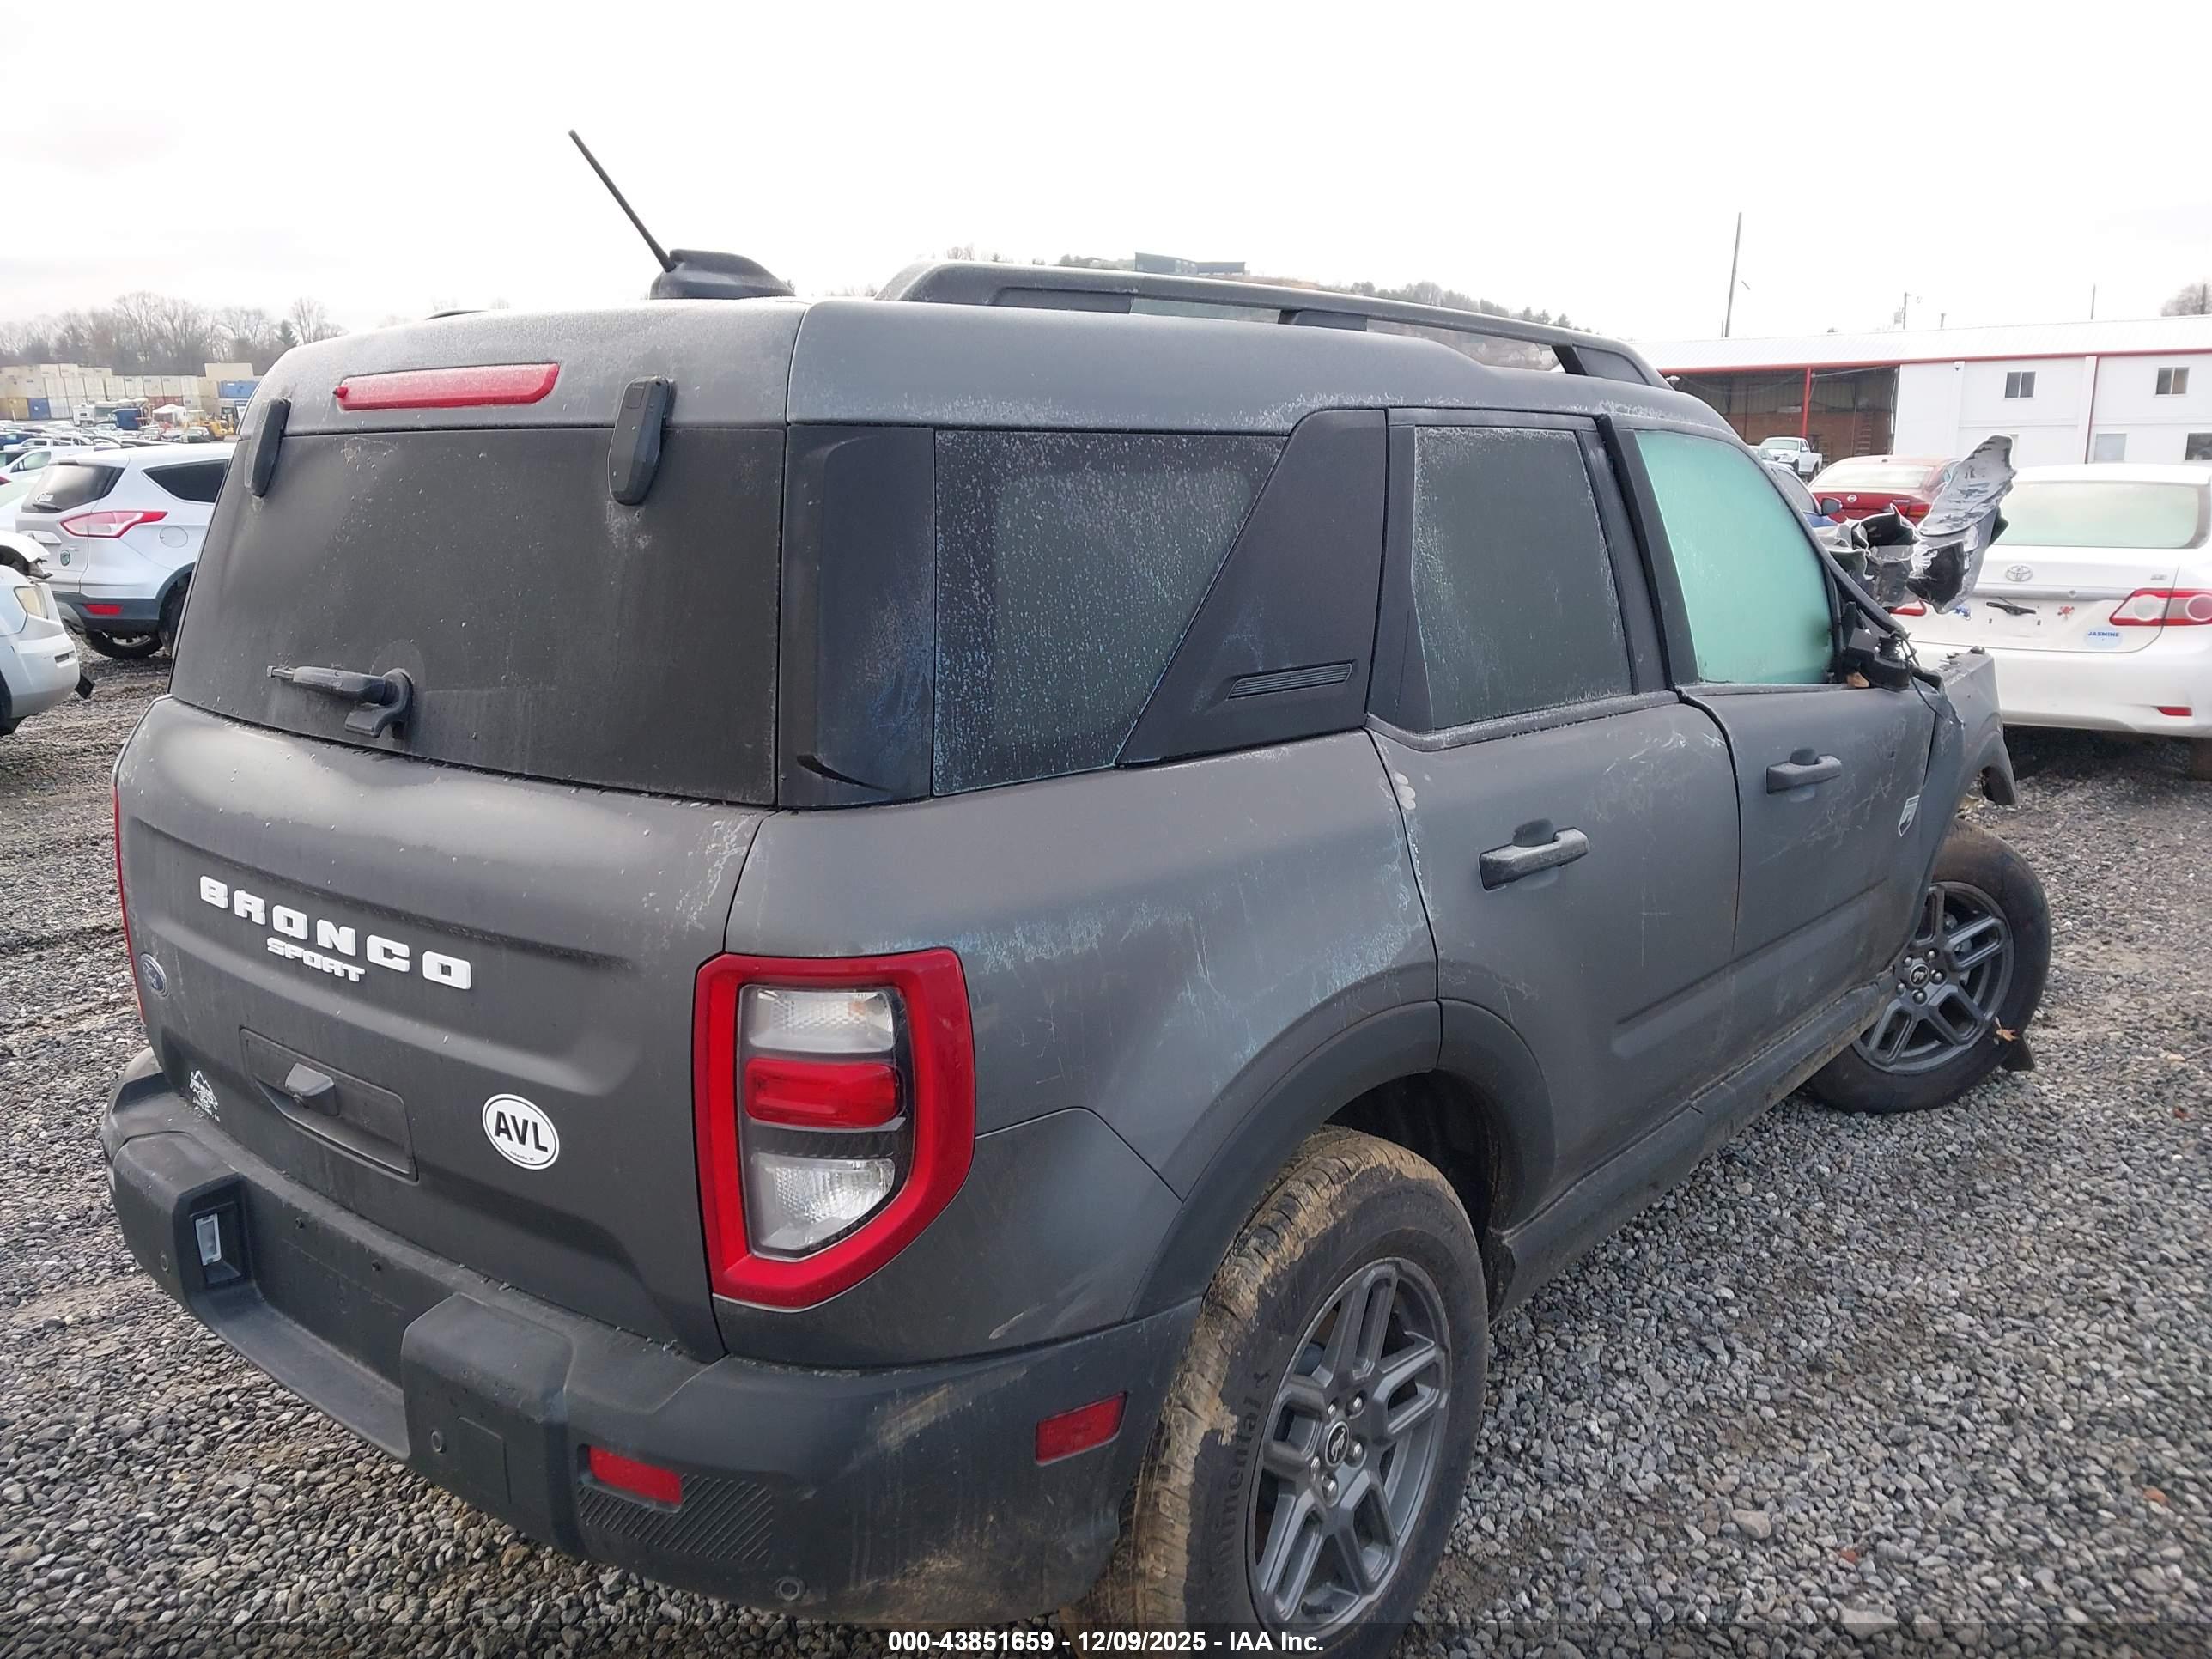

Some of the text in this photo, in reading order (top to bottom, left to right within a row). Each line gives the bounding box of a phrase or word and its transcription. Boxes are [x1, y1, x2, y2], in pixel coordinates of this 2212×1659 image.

[199, 875, 471, 989] BRONCO
[266, 937, 366, 982] SPORT
[495, 1110, 549, 1153] AVL
